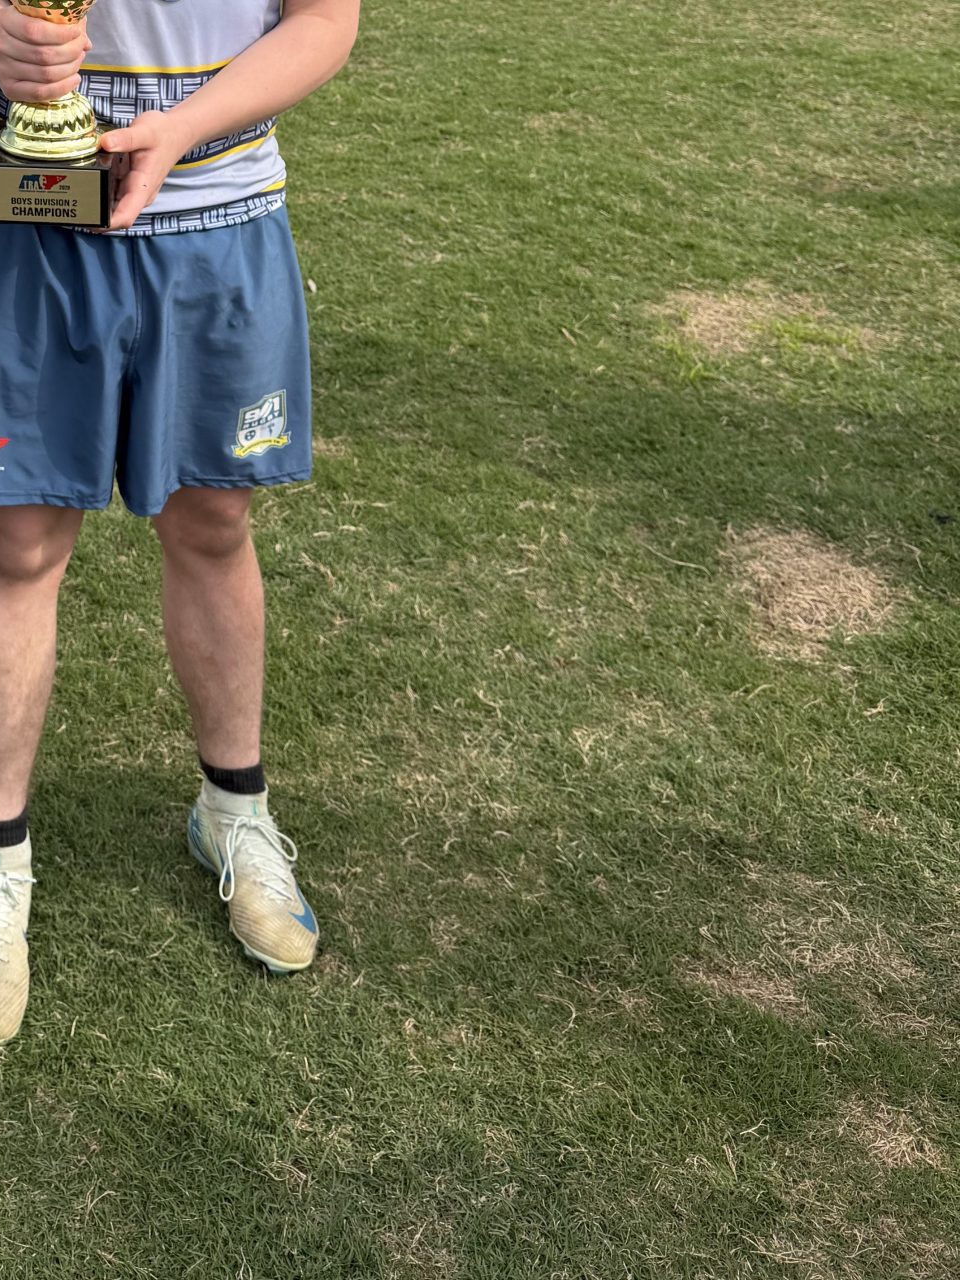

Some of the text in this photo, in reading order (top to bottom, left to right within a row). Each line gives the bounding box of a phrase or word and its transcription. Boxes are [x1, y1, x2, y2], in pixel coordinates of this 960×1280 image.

[23, 180, 39, 190] TRA
[11, 197, 78, 207] BOYS DIVISION 2
[12, 207, 77, 218] CHAMPIONS
